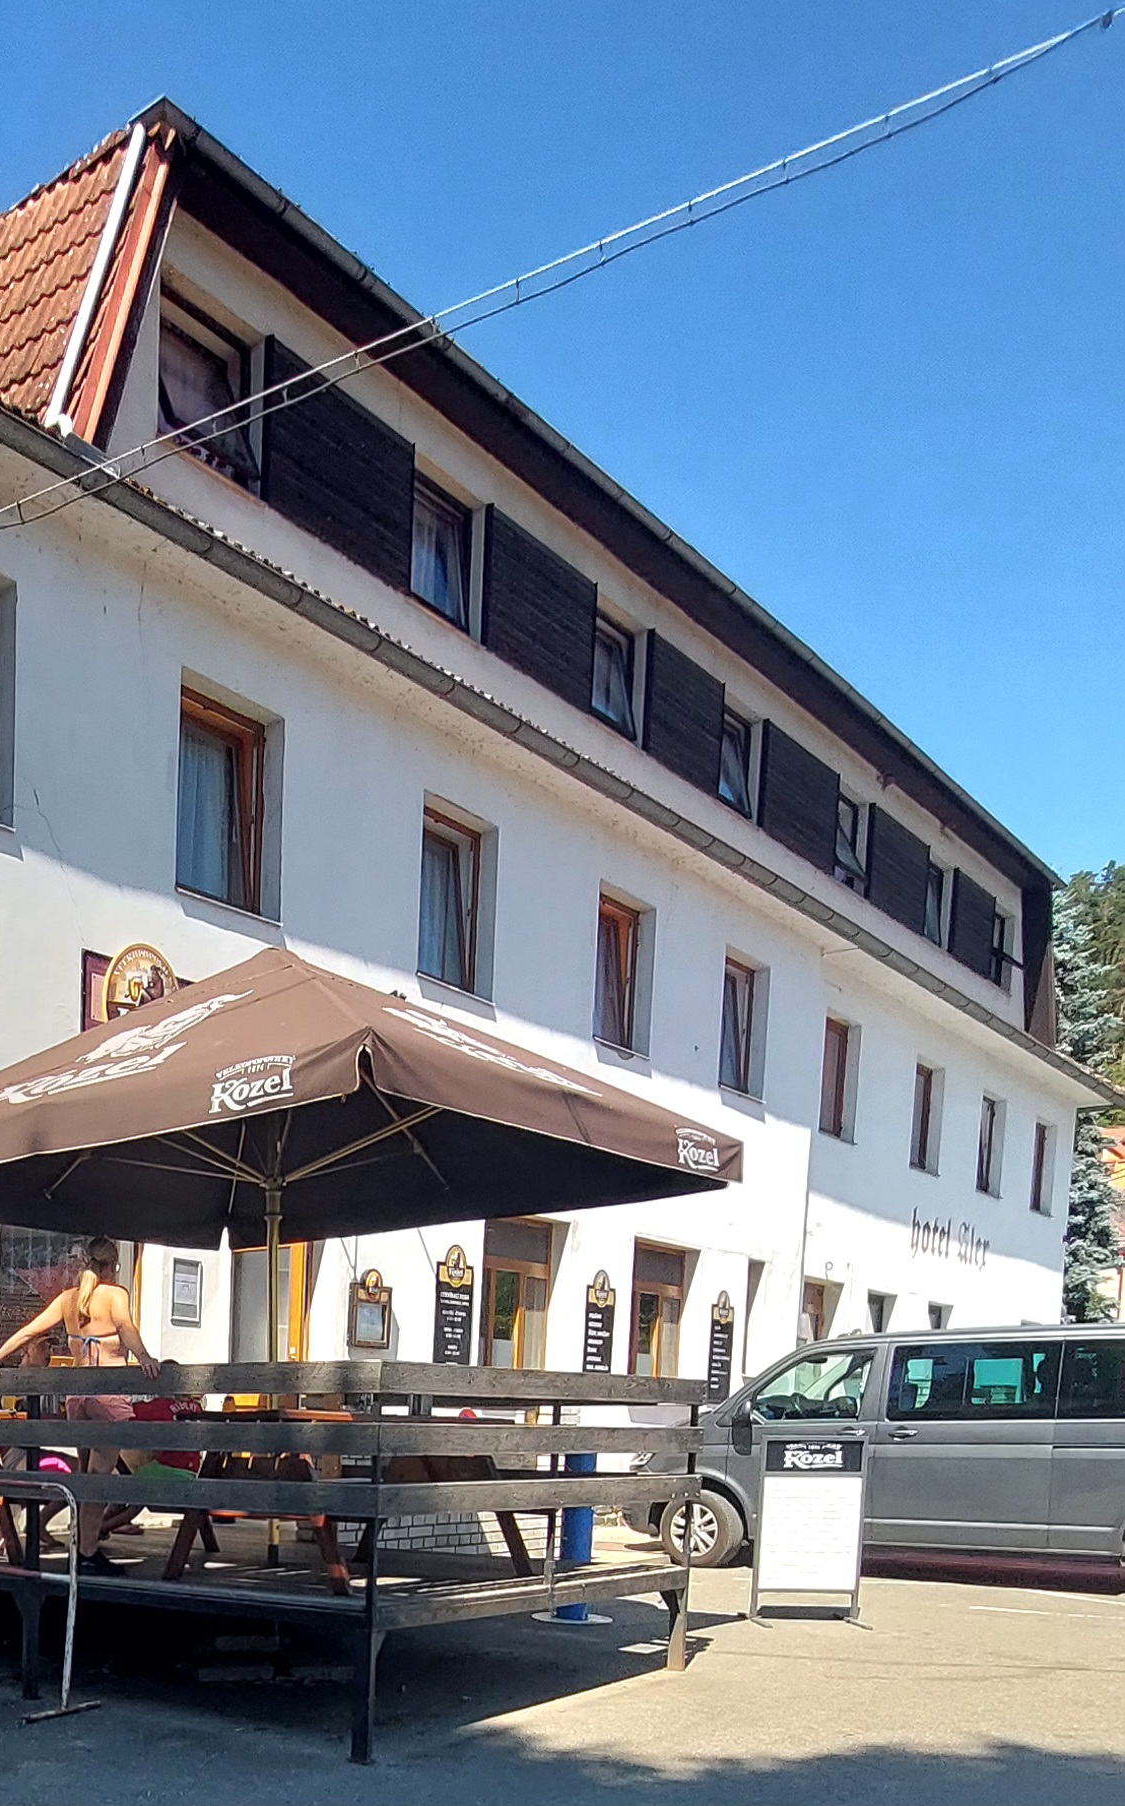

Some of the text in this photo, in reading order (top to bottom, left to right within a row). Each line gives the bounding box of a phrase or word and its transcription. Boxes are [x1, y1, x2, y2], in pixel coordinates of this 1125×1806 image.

[209, 1067, 294, 1114] Kozel
[677, 1137, 721, 1172] Kozel
[911, 1206, 952, 1260] hotel
[783, 1450, 844, 1470] Kozel
